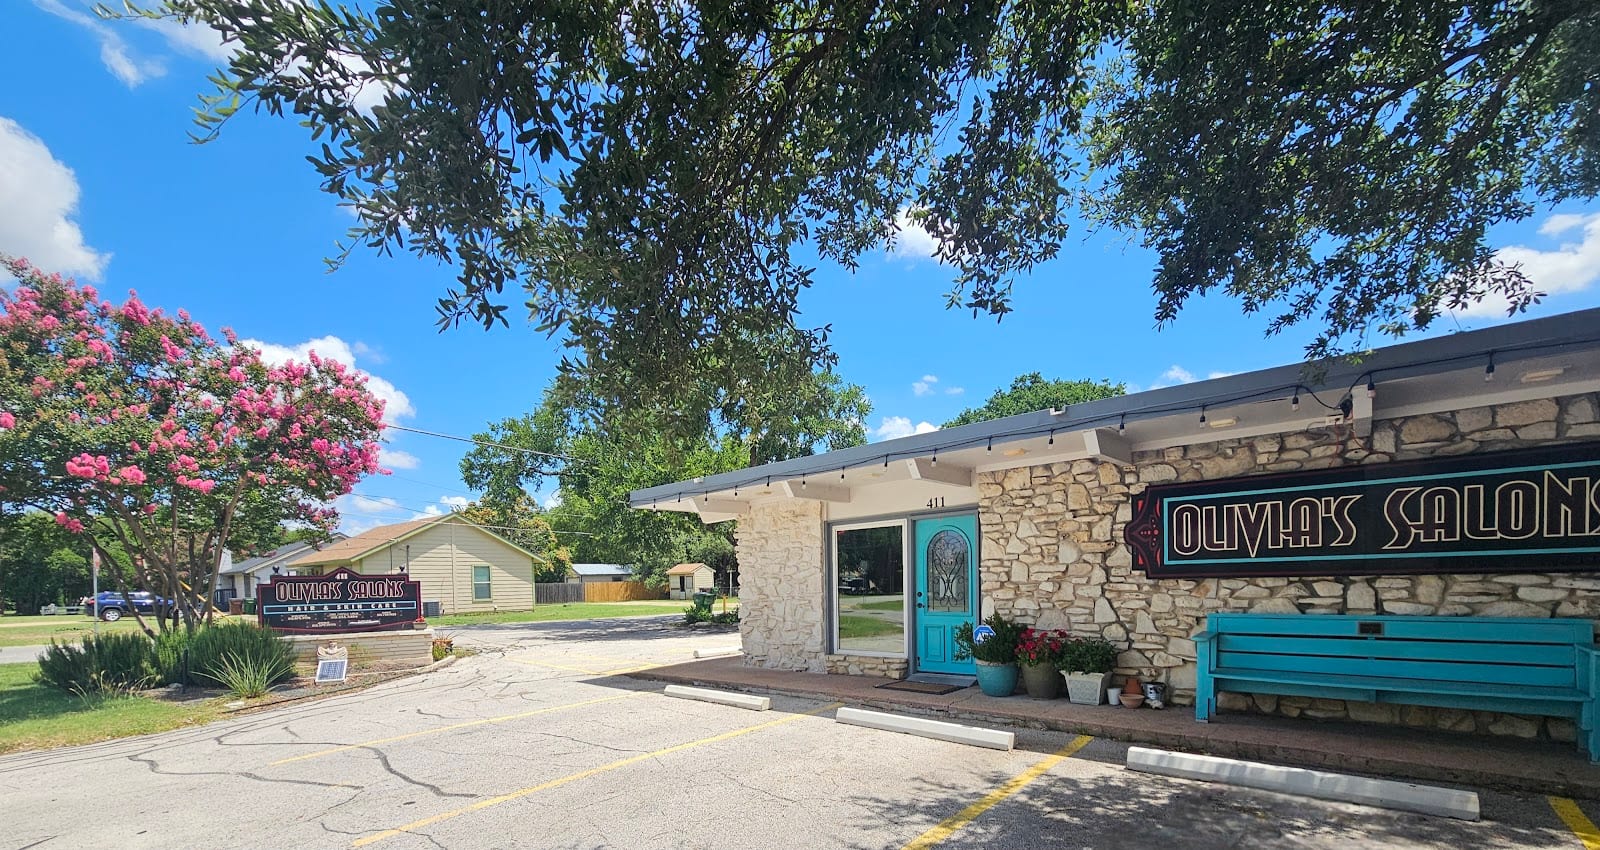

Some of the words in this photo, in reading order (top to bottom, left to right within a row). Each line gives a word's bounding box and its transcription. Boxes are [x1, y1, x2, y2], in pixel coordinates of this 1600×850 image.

[926, 496, 945, 509] 411
[1173, 494, 1365, 558] OLIVIA'S
[275, 581, 343, 604] OLIVIA'S
[347, 578, 405, 601] SALONS
